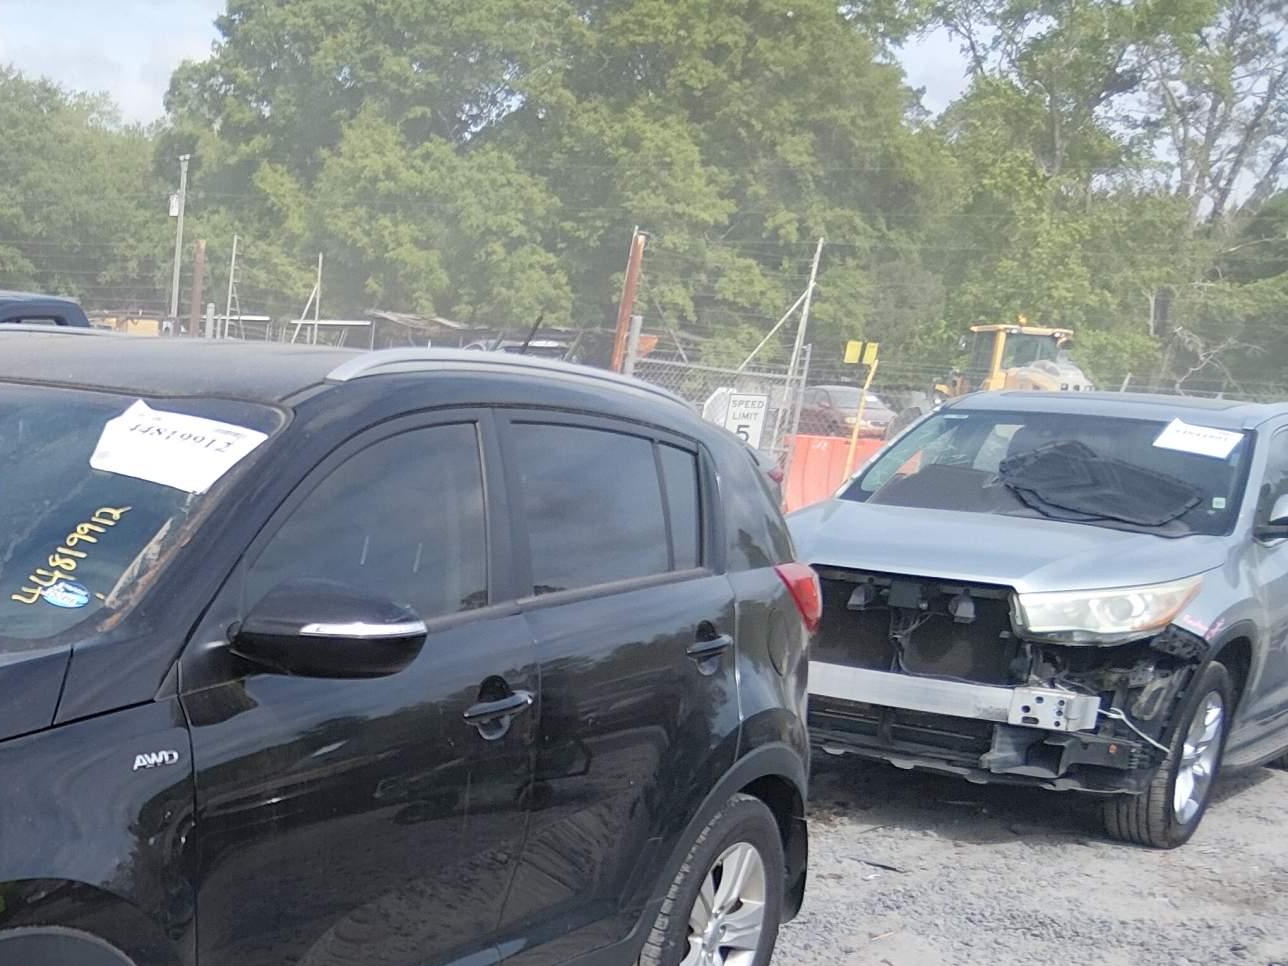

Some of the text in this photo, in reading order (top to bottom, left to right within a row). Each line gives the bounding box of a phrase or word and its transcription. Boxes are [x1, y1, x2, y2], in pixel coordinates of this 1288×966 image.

[731, 399, 765, 409] SPEED
[732, 410, 759, 421] LIMIT
[735, 424, 750, 442] 5
[11, 505, 132, 604] 44819912
[132, 749, 179, 771] AWD
